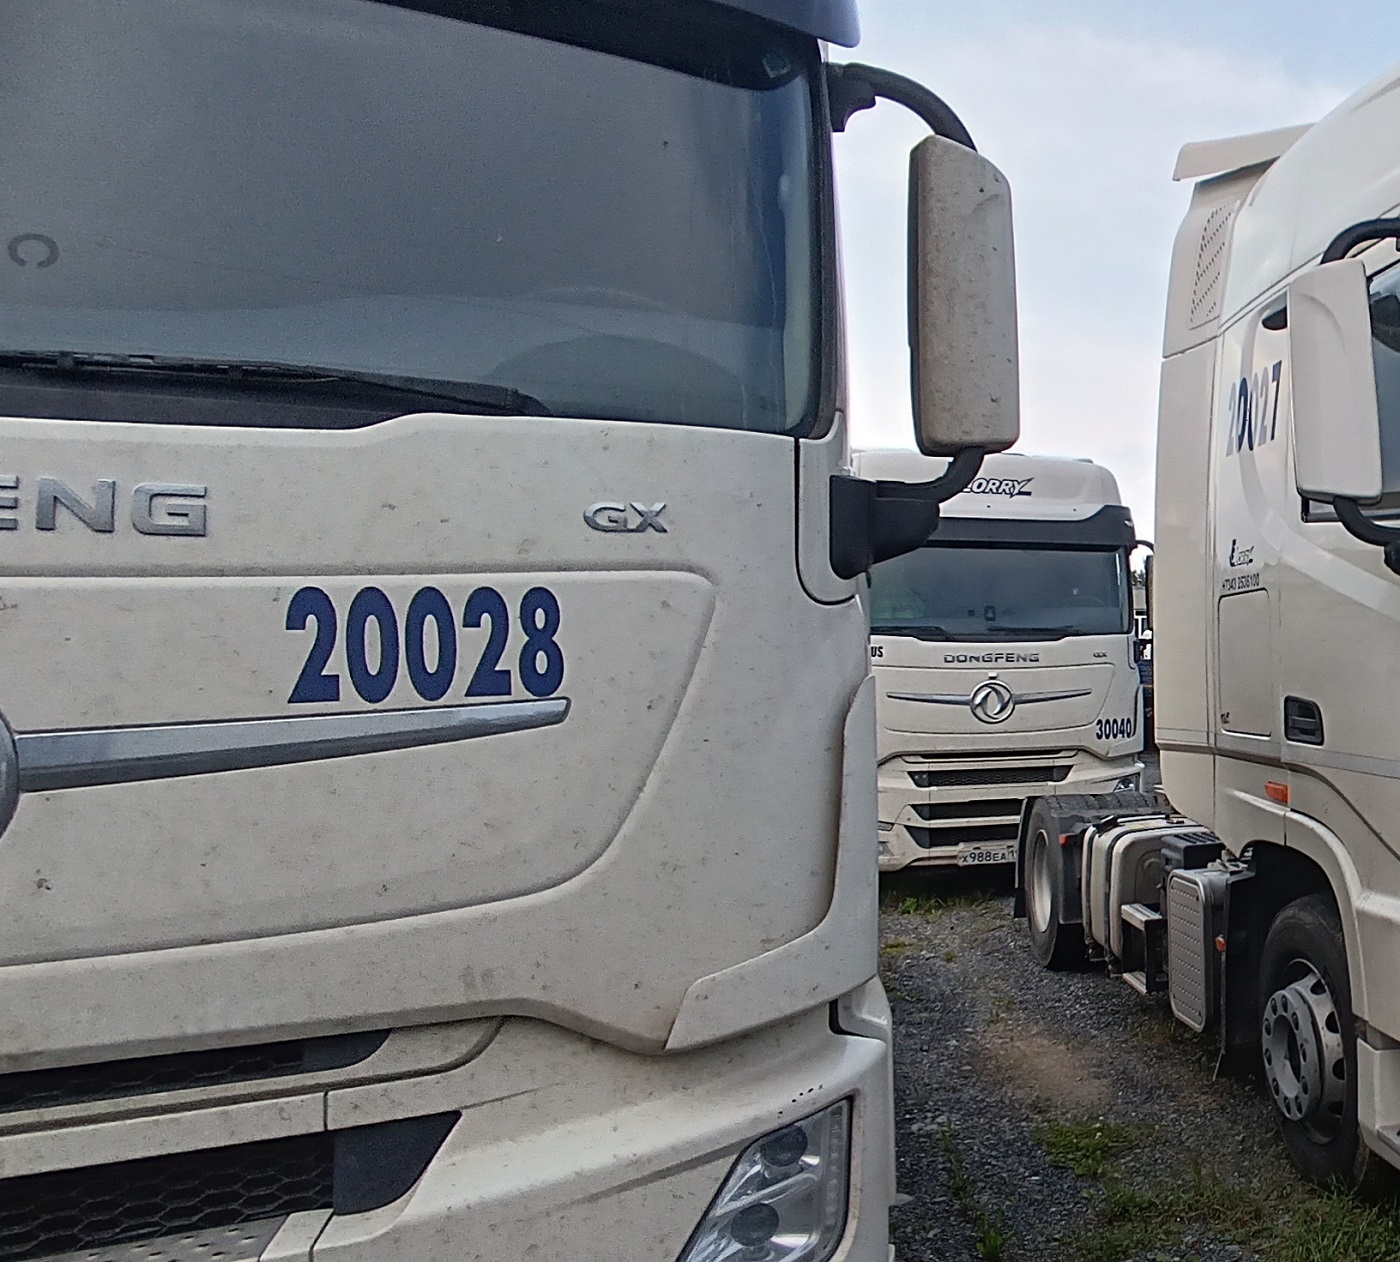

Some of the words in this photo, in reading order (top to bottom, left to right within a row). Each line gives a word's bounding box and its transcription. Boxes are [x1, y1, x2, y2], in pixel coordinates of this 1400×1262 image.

[1226, 360, 1283, 457] 20027
[583, 502, 668, 533] GX
[286, 586, 564, 704] 20028
[943, 652, 1040, 664] DONGFENG
[1095, 717, 1133, 740] 30040
